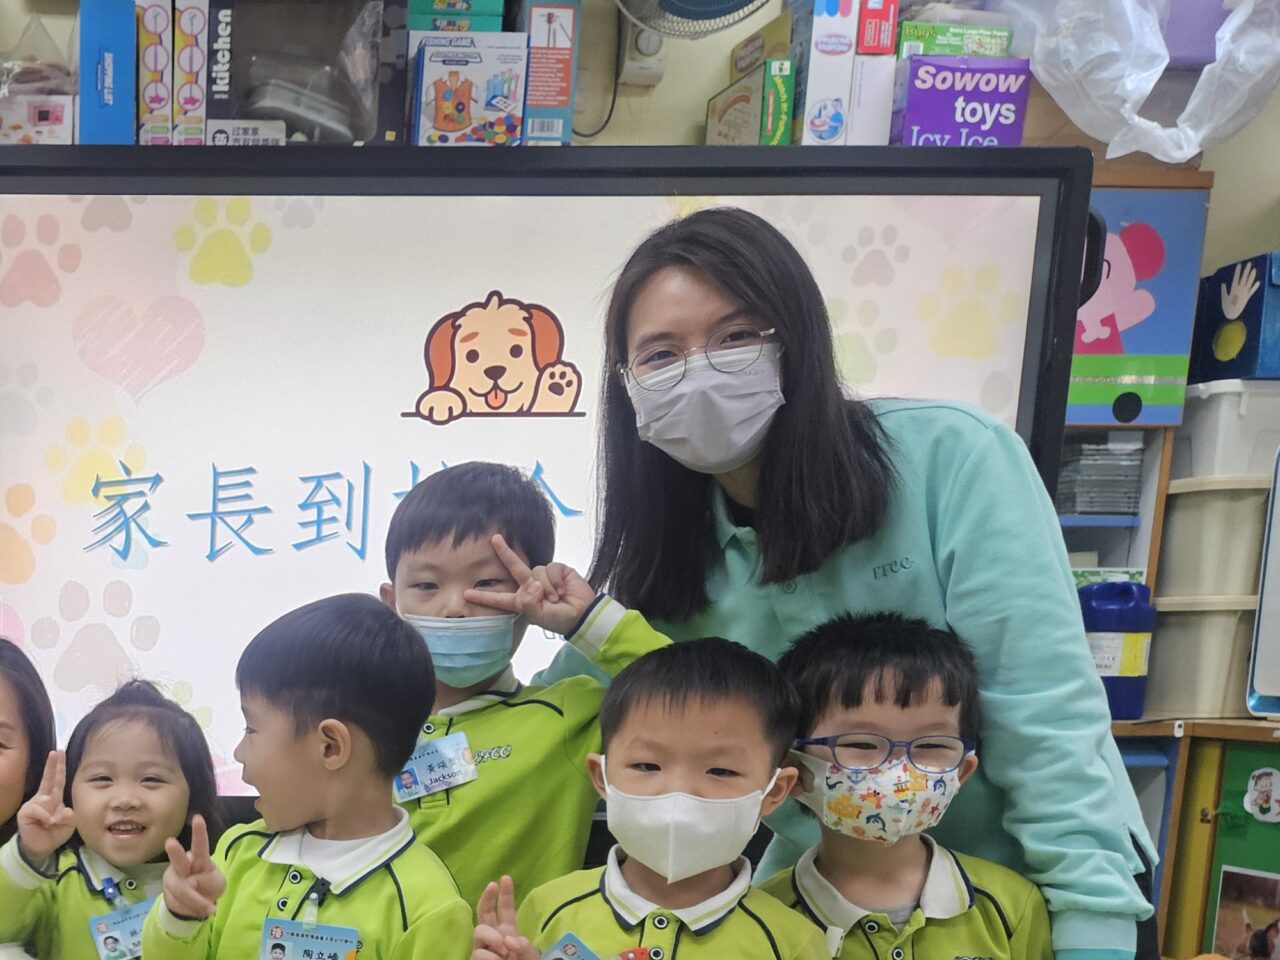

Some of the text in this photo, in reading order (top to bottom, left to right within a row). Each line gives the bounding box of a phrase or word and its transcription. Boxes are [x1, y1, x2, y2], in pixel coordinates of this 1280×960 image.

[211, 9, 232, 91] kitchen
[914, 65, 1026, 93] Sowow
[954, 96, 1016, 131] toys
[959, 128, 998, 147] Ice
